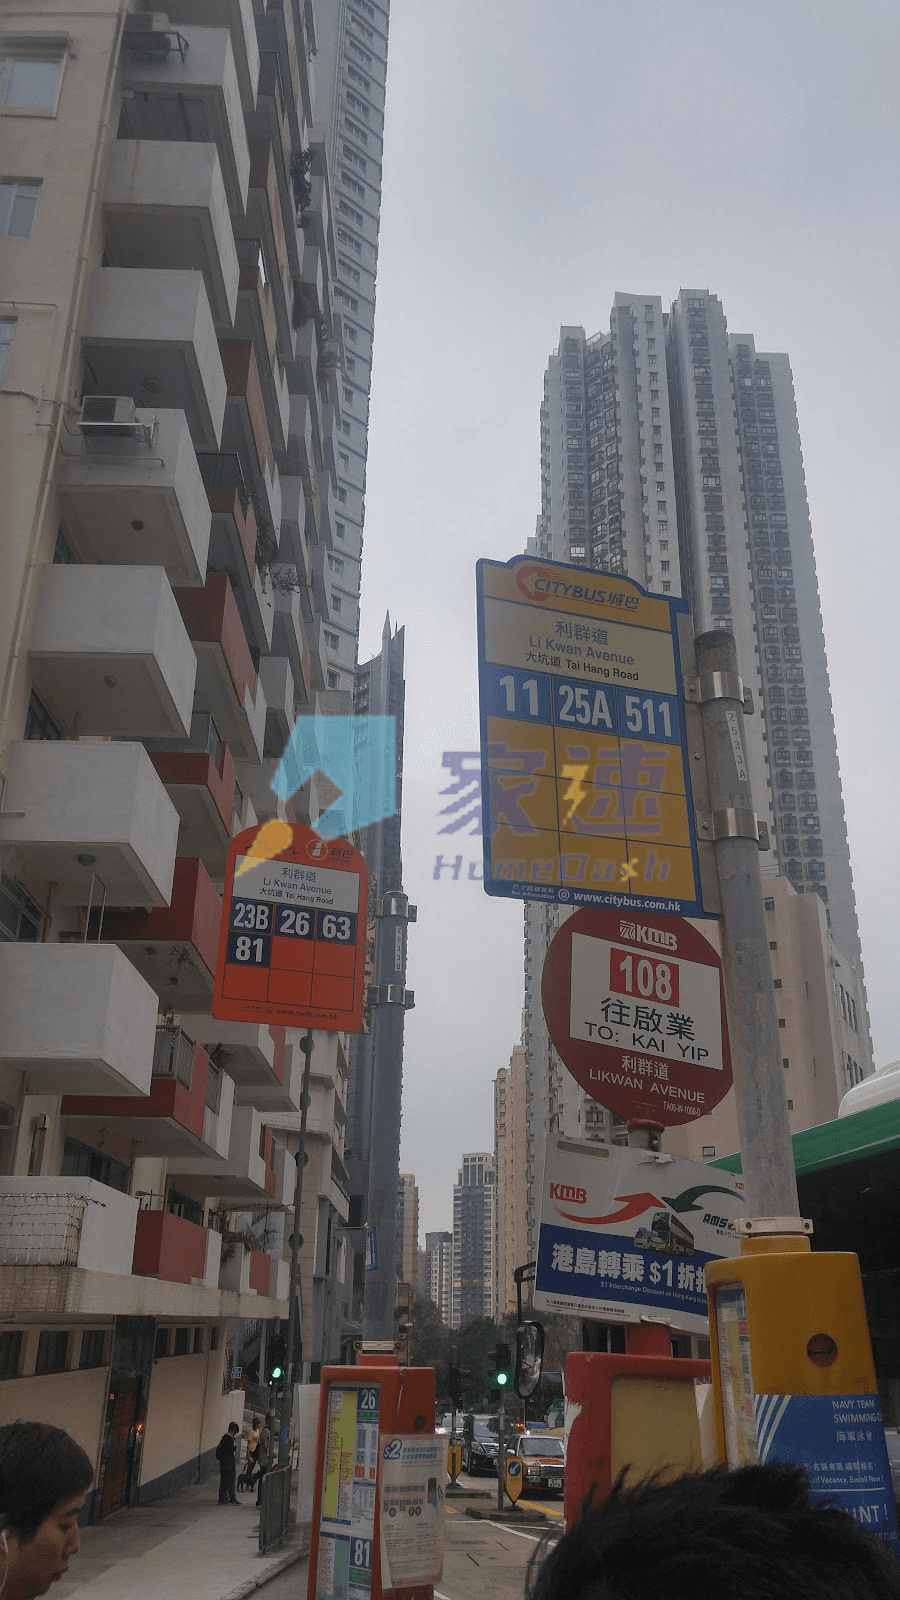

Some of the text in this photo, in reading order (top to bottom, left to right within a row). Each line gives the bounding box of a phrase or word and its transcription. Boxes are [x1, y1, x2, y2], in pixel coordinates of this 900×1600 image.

[534, 577, 640, 610] CITYBUS 城巴
[555, 621, 609, 646] 利群道
[529, 635, 635, 666] Li Kwan Avenue
[525, 652, 639, 681] 大坑道 Tai Hang Road
[500, 675, 672, 737] 11 25A 511
[728, 712, 747, 779] 2533A
[263, 877, 332, 895] Li Kwan Avenue
[281, 867, 317, 883] 利群道
[259, 887, 334, 905] 大坑道 Tai Hang Road
[573, 891, 681, 912] www.citybus.com.hk
[233, 902, 350, 940] 23B 26 63
[235, 936, 264, 962] 81
[636, 923, 678, 950] KMB
[619, 955, 672, 1000] 108
[600, 997, 695, 1041] 往啟業
[584, 1021, 709, 1061] TO: KAI YIP
[621, 1055, 669, 1081] 利群道
[589, 1069, 705, 1104] LIKWAN AVENUE
[550, 1183, 587, 1204] KMB
[551, 1242, 645, 1283] 港島轉乘
[649, 1259, 674, 1288] $1
[609, 1282, 642, 1294] Interchange
[642, 1286, 665, 1296] Discount
[672, 1291, 685, 1301] Hong
[361, 1388, 376, 1410] 26
[832, 1400, 875, 1409] NAVY TEAM
[833, 1413, 876, 1424] SWIMMING
[383, 1438, 403, 1460] $2
[354, 1539, 370, 1567] 81
